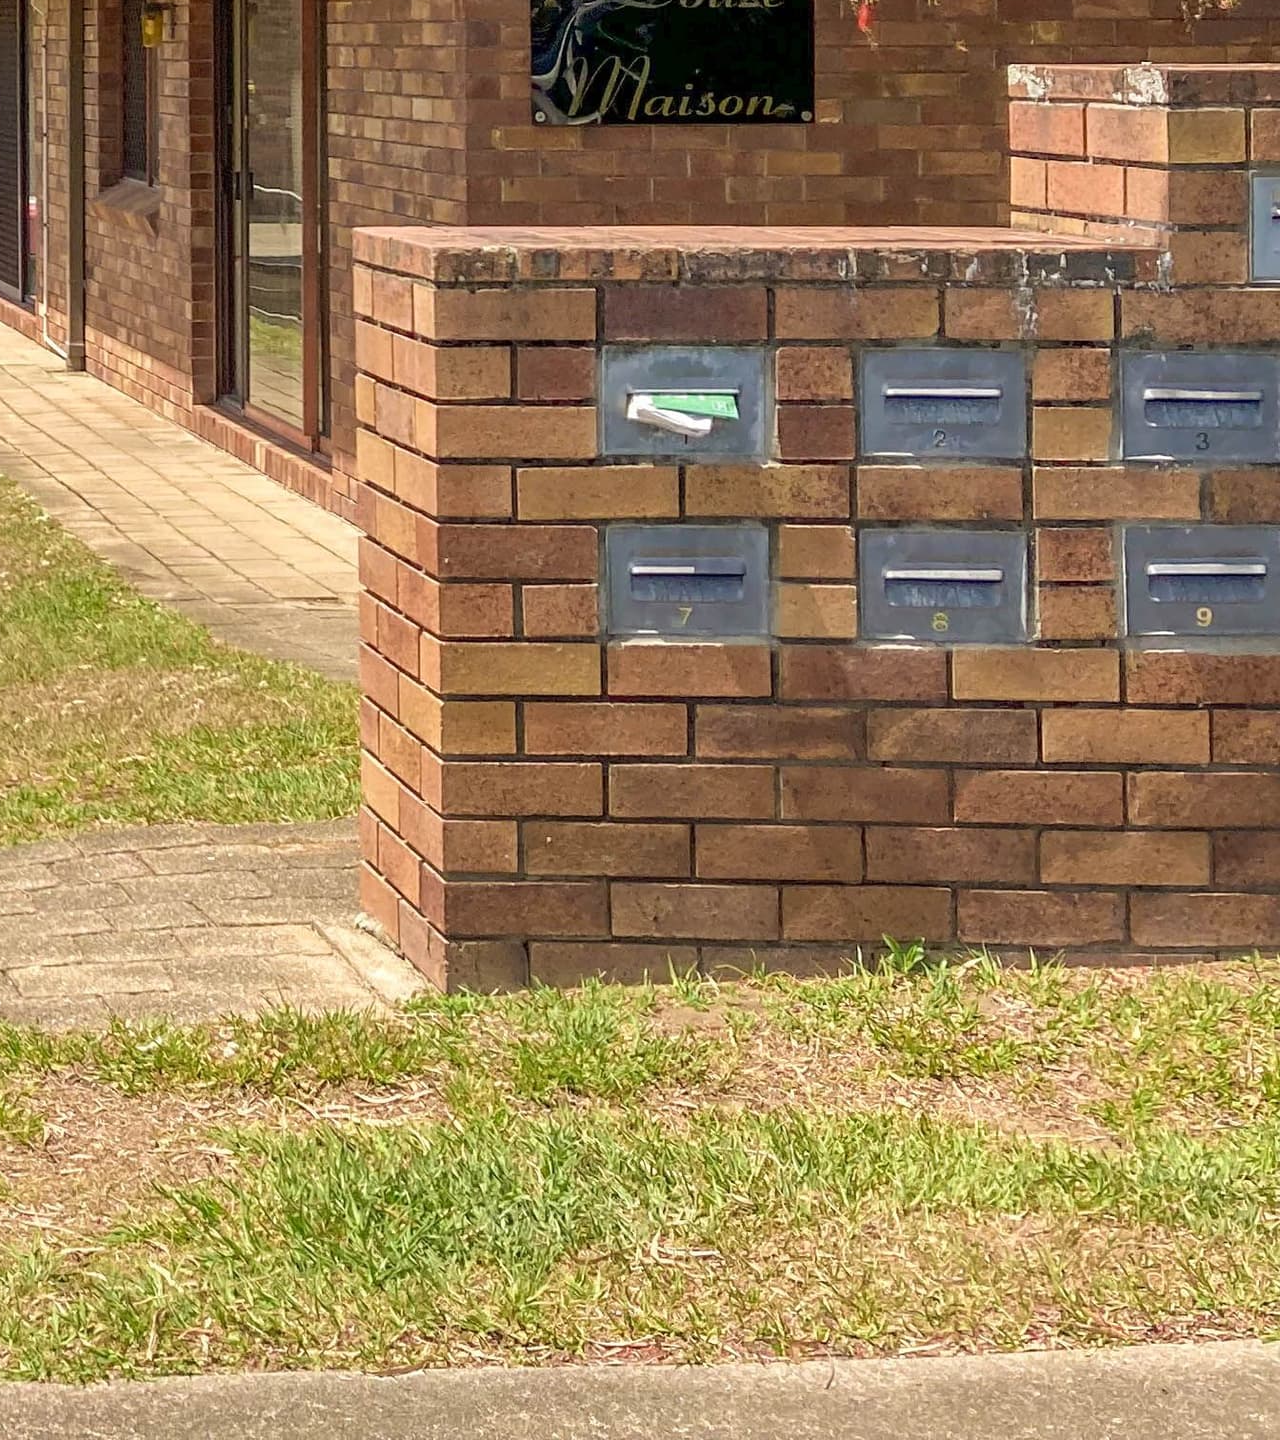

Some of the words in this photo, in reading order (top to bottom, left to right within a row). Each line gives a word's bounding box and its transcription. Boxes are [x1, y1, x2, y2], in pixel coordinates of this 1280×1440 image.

[567, 55, 795, 121] Maison
[934, 429, 946, 448] 2
[1195, 431, 1211, 450] 3
[679, 607, 692, 625] 7
[931, 612, 948, 632] 8
[1195, 607, 1214, 627] 9
